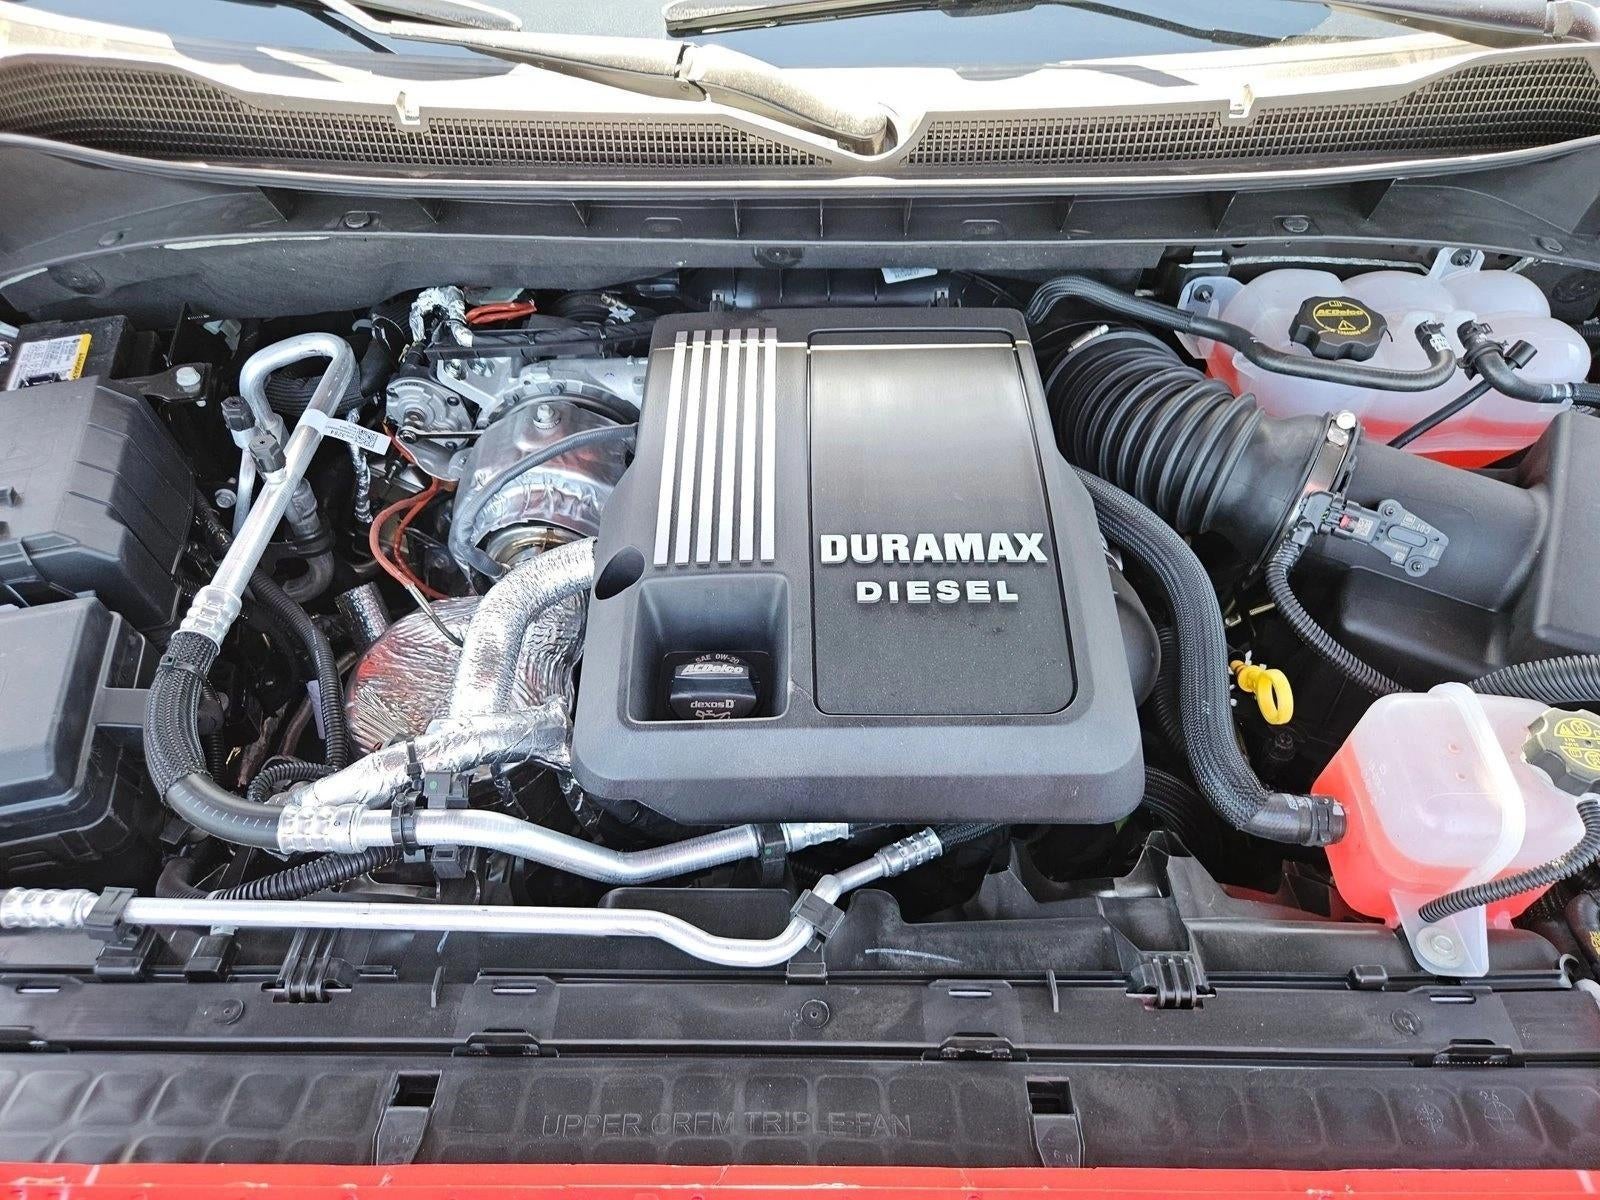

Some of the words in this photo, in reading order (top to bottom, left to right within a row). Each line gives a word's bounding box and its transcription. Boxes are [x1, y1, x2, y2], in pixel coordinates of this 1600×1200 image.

[1316, 308, 1364, 317] ACDelco
[820, 532, 1048, 564] DURAMAX
[856, 580, 1019, 604] DIESEL
[695, 653, 712, 665] SAE
[680, 663, 744, 676] ACDelco
[542, 1113, 643, 1138] UPPER
